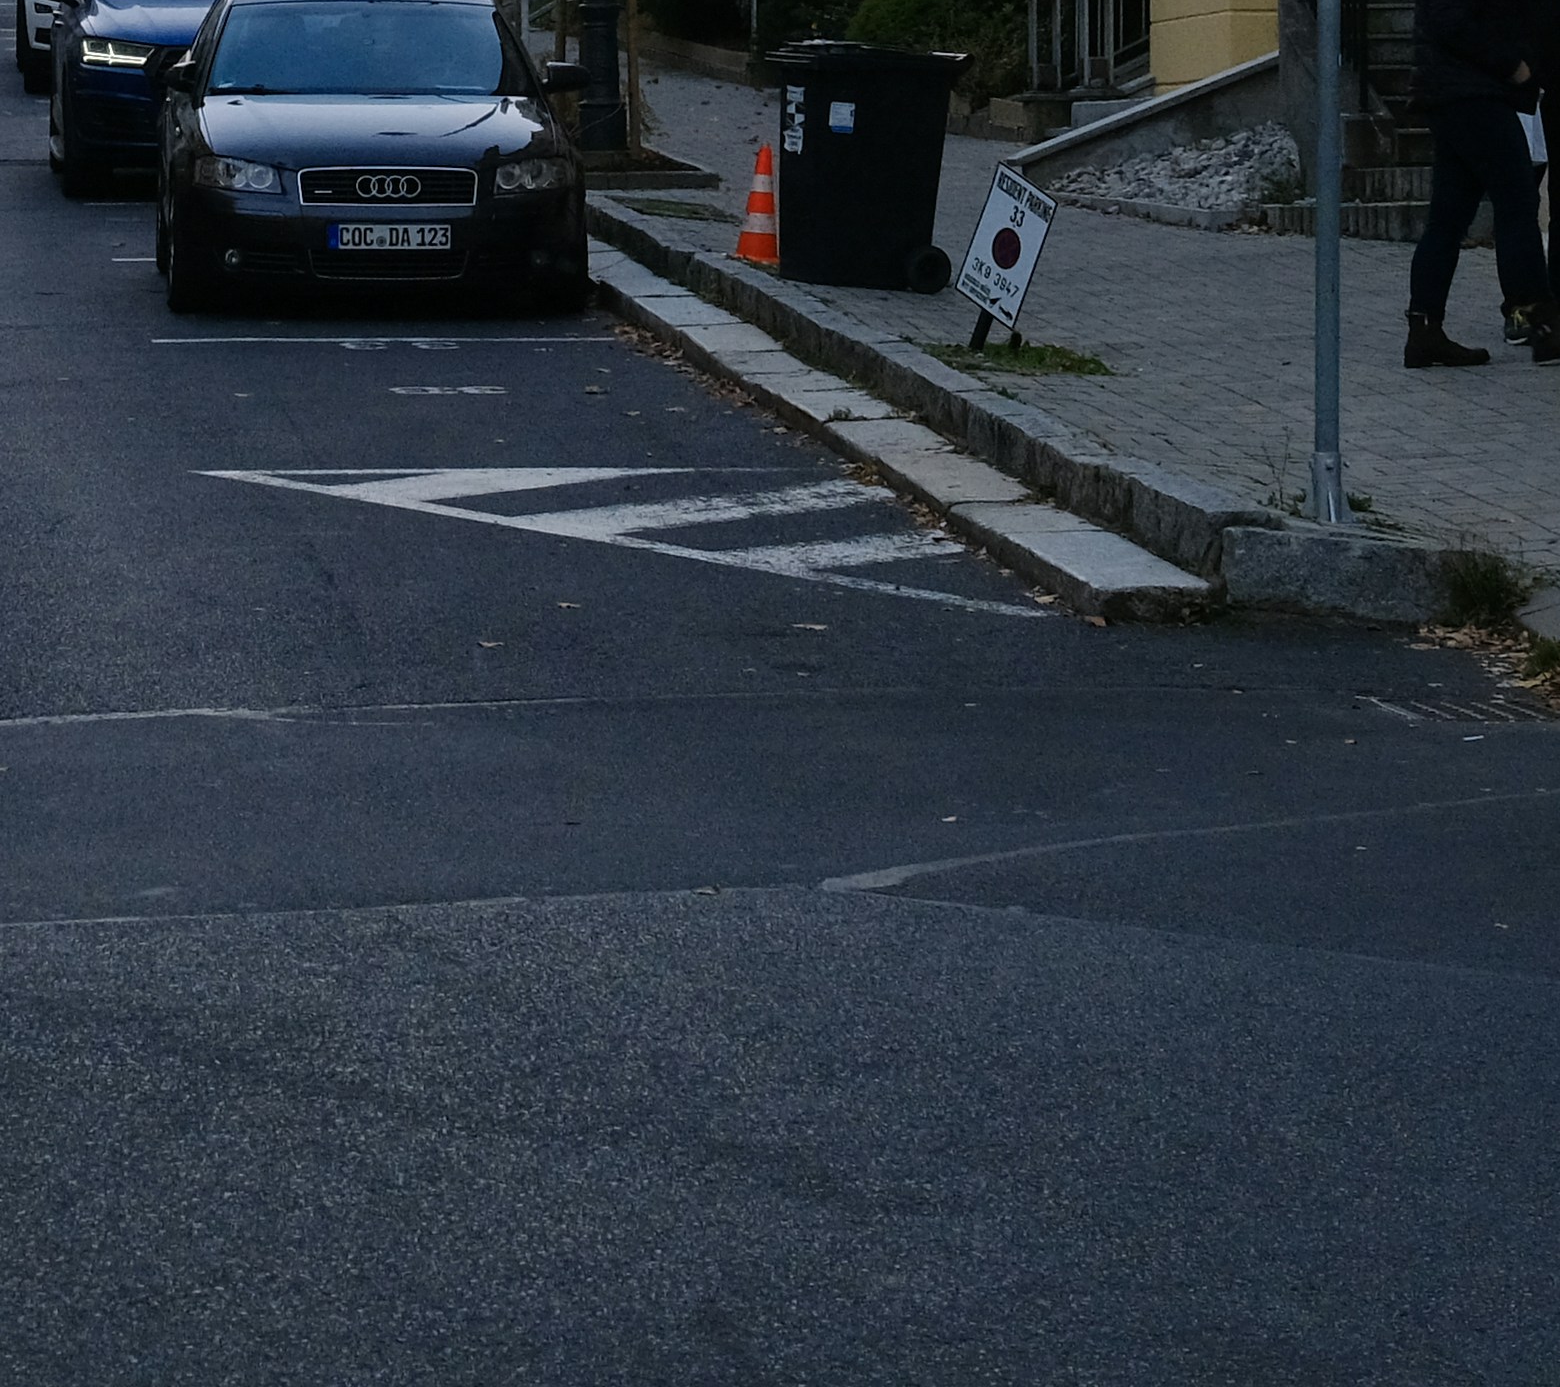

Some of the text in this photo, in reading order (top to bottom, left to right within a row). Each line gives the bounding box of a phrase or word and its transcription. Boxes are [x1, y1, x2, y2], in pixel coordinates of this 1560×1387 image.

[1010, 205, 1026, 228] 33
[340, 227, 449, 246] COC DA 123
